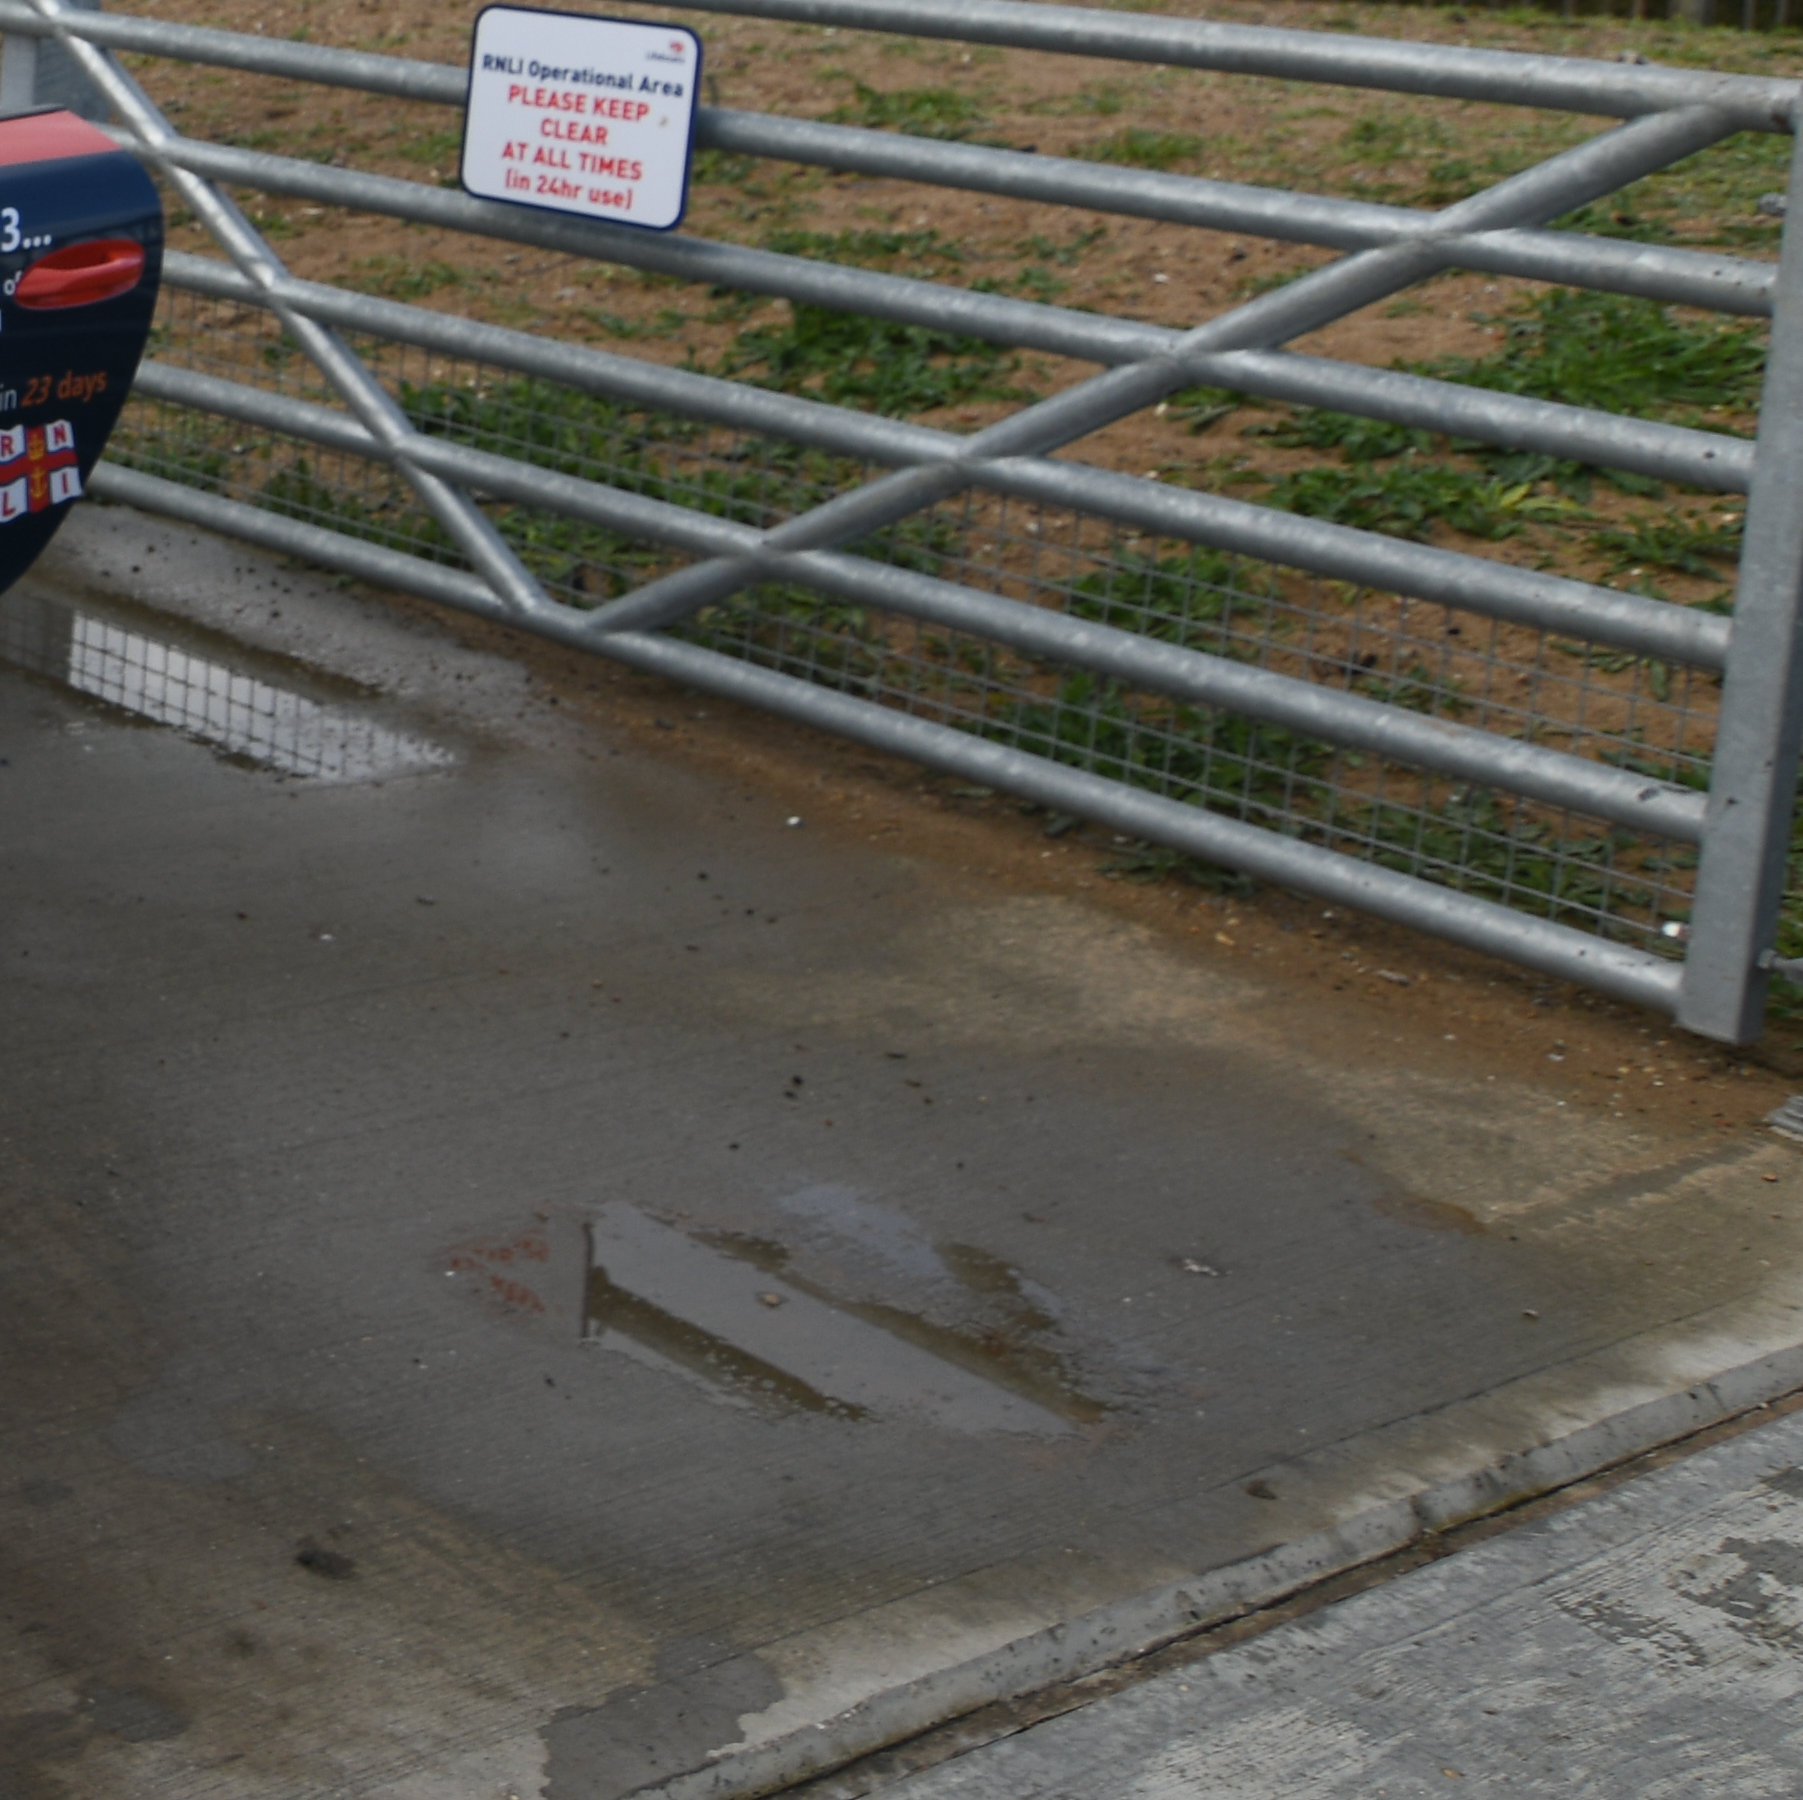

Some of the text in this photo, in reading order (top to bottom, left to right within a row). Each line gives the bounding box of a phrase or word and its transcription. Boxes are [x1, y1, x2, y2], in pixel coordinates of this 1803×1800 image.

[482, 54, 684, 98] RNLI Operational Area
[508, 84, 651, 123] PLEASE KEEP
[540, 118, 608, 147] CLEAR
[501, 142, 644, 181] AT ALL TIMES
[535, 174, 584, 201] 24hr
[23, 375, 53, 407] 23
[57, 370, 108, 400] days
